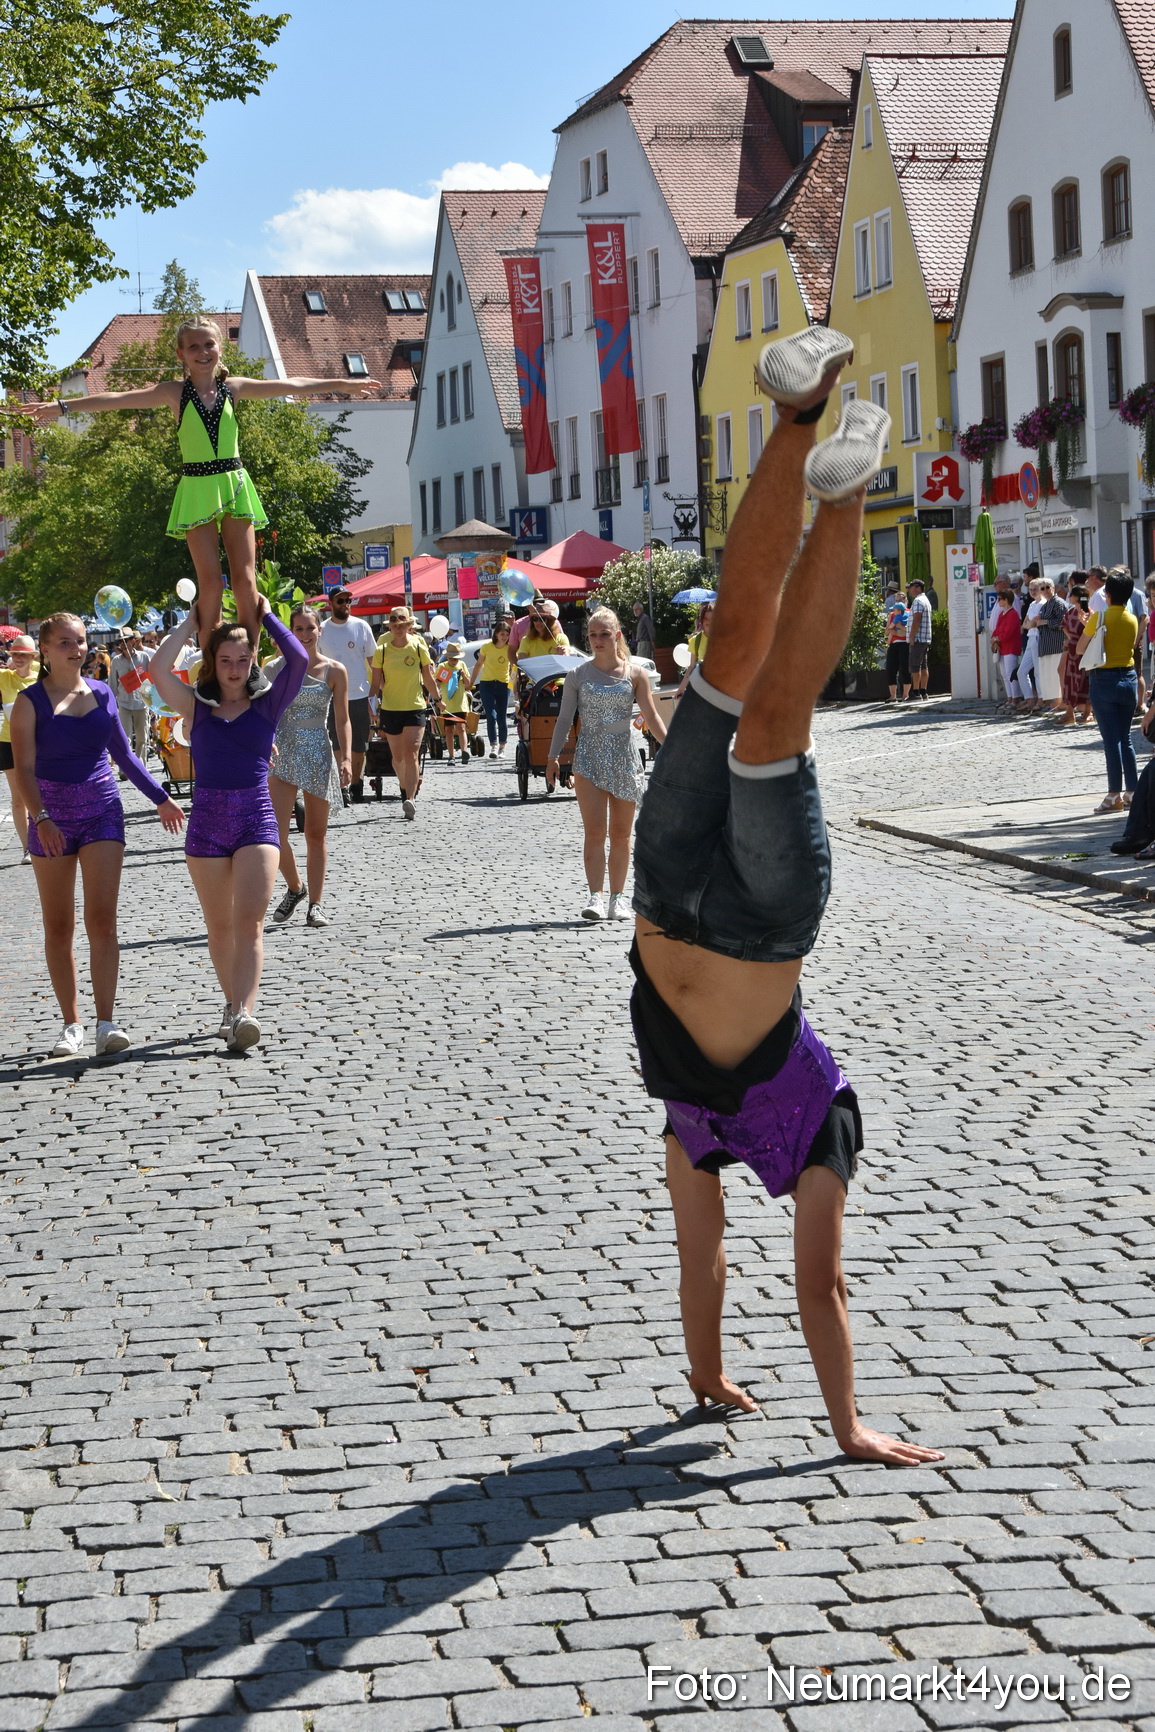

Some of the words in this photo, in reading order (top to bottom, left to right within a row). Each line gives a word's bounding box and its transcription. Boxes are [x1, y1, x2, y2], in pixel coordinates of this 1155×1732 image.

[593, 231, 619, 285] K&L
[612, 231, 624, 284] RUPPERT
[996, 524, 1014, 534] APOTHEKE
[1052, 516, 1072, 527] APOTHEKE
